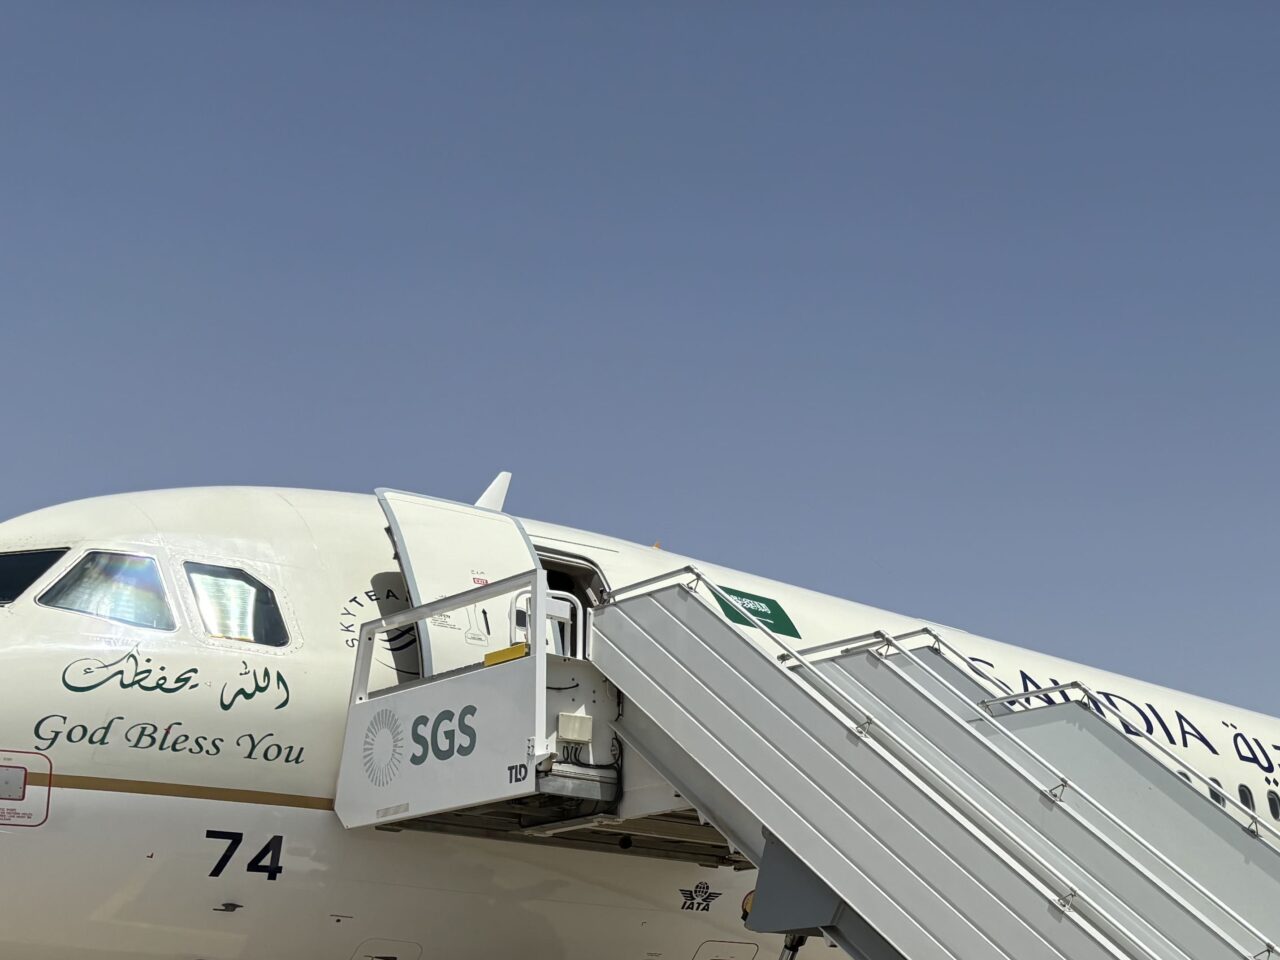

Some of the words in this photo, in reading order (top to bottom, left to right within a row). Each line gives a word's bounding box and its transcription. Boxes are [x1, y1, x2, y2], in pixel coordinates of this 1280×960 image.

[339, 588, 409, 649] SKYTEA
[34, 714, 124, 751] God
[124, 722, 224, 756] Bless
[235, 733, 305, 764] You
[409, 704, 478, 766] SGS
[507, 763, 528, 784] TLD
[206, 830, 283, 881] 74
[680, 900, 711, 912] IATA
